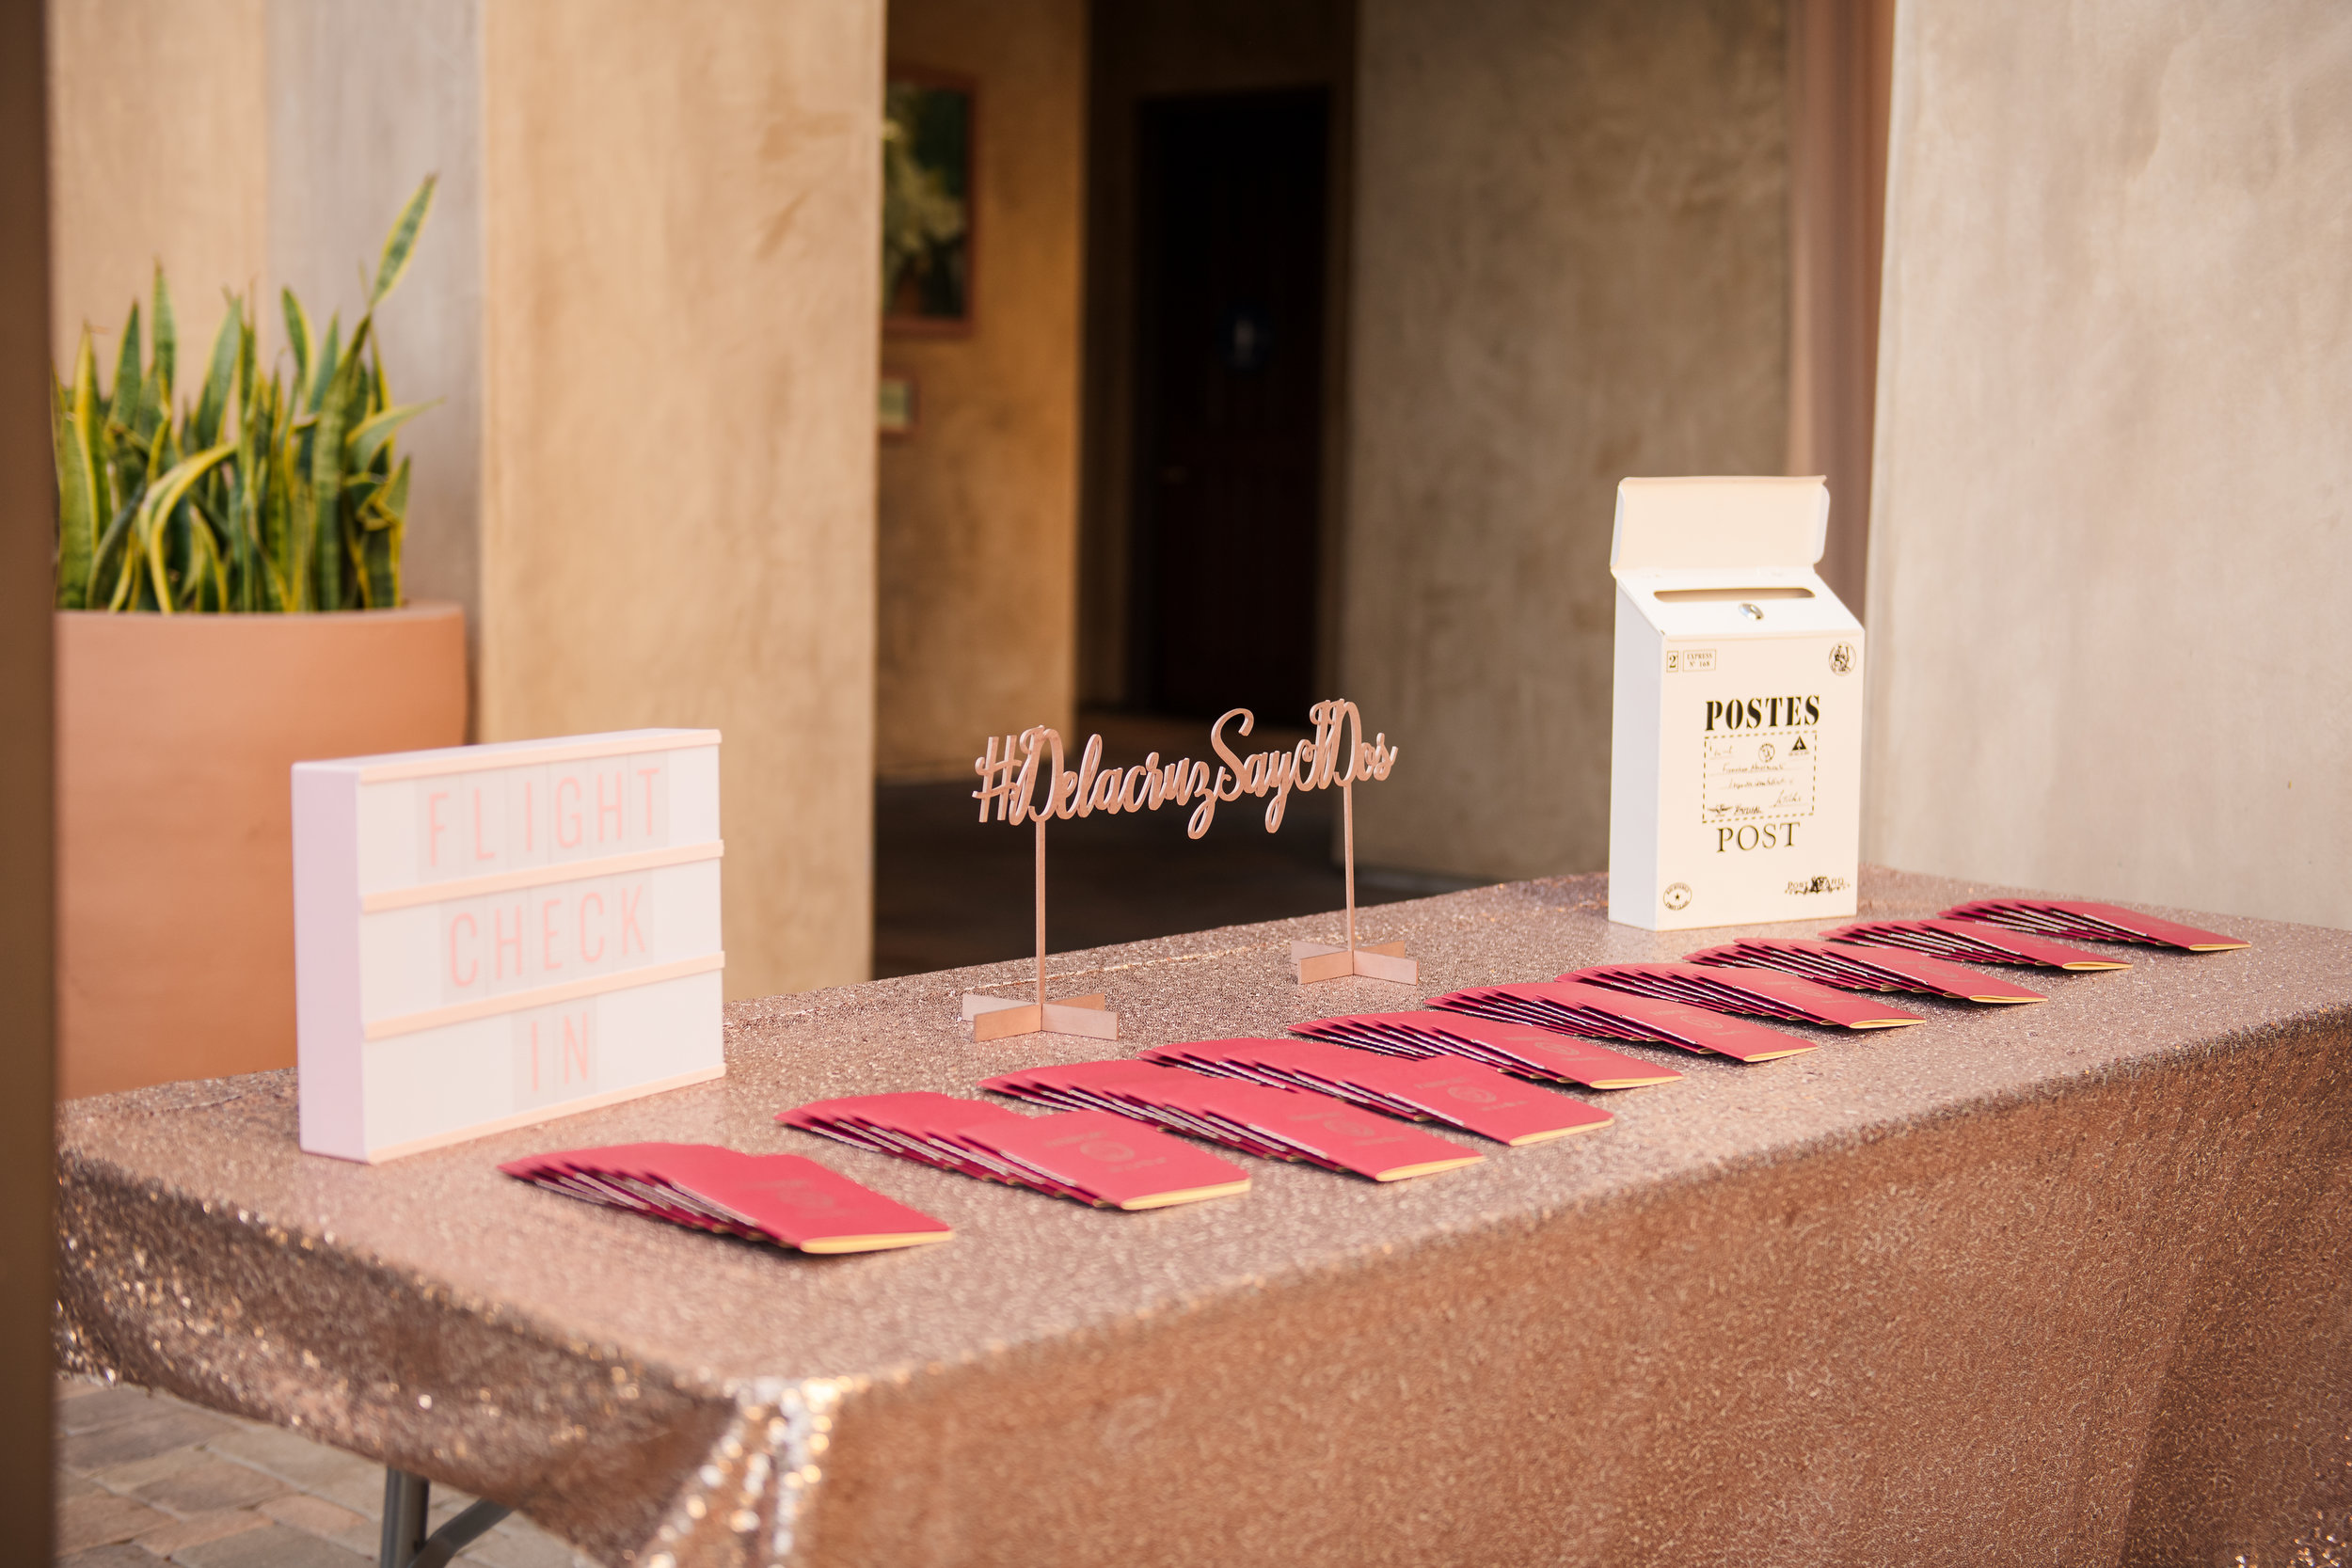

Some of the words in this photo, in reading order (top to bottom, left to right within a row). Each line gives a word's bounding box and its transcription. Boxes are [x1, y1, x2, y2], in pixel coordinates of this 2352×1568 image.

[1669, 655, 1677, 668] 2
[1705, 694, 1820, 731] POSTES
[428, 768, 660, 867] FLIGHT
[1716, 821, 1801, 853] POST
[449, 884, 646, 988] CHECK
[531, 1011, 589, 1093] IN
